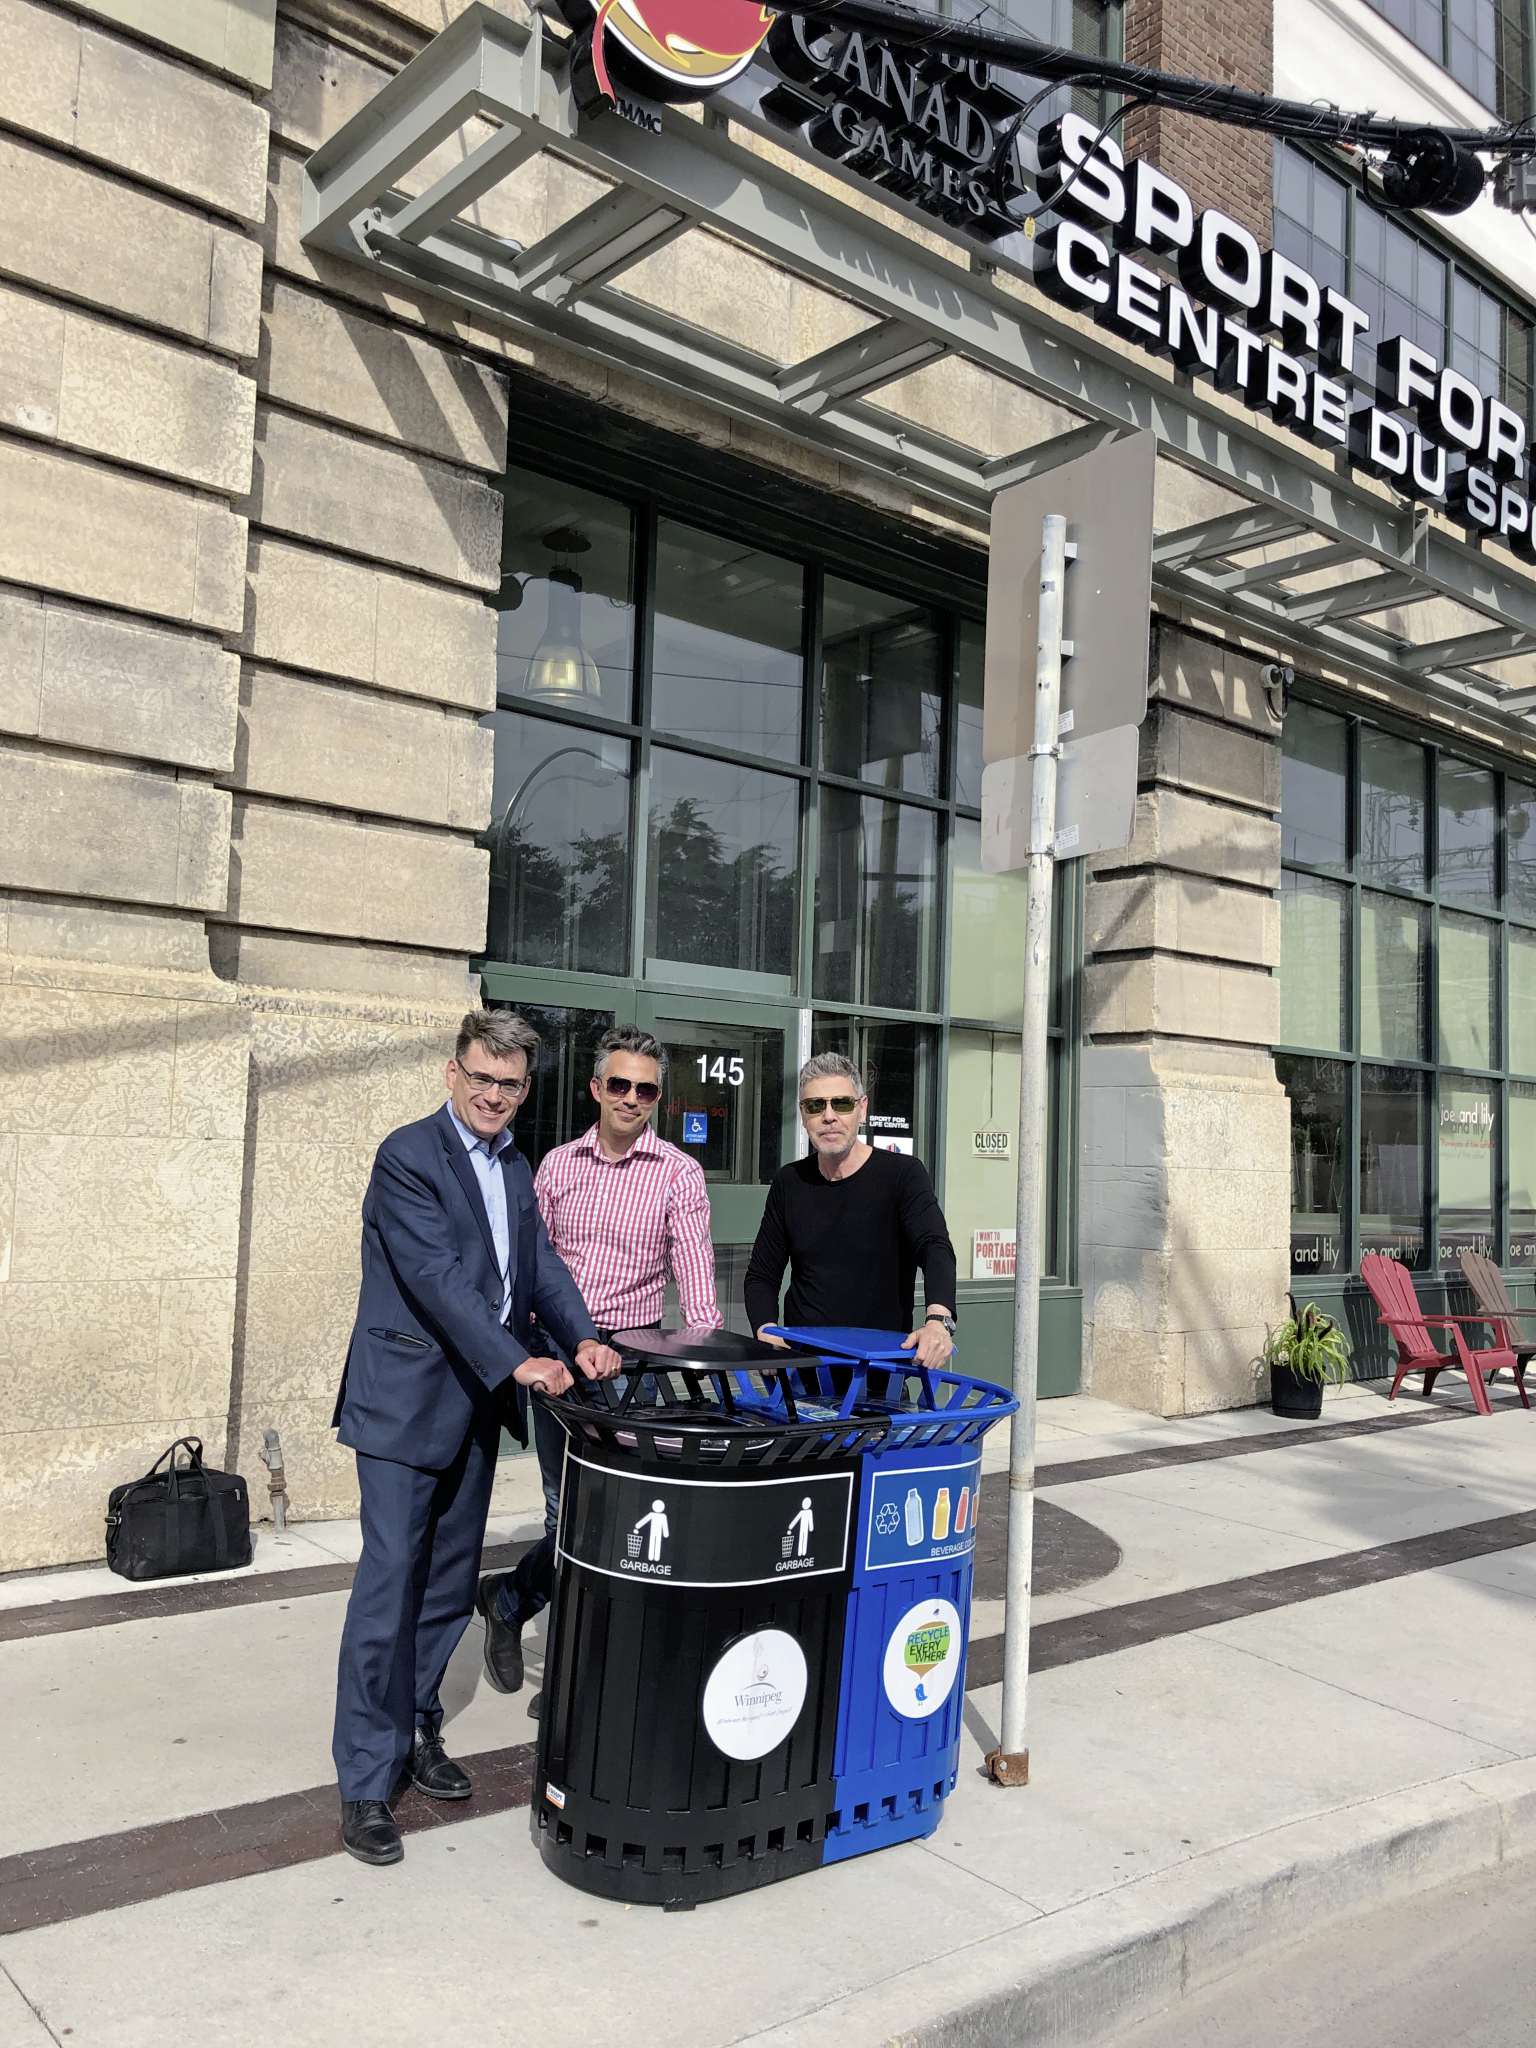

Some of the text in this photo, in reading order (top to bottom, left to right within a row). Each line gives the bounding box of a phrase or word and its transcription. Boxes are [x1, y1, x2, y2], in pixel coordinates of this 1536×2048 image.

[832, 101, 988, 217] GAMES
[1060, 112, 1526, 480] SPORT FOR
[1056, 221, 1536, 552] CENTRE DU SP
[697, 1054, 745, 1087] 145
[1440, 1102, 1495, 1132] joe and lily
[975, 1133, 1008, 1148] CLOSED
[979, 1231, 993, 1241] WANT
[994, 1231, 1000, 1241] TO
[976, 1242, 1016, 1259] PORTAGE
[1294, 1236, 1340, 1270] and lily
[1405, 1236, 1420, 1267] lily
[1509, 1244, 1536, 1257] oe an
[993, 1259, 1016, 1275] MAIN
[931, 1541, 965, 1557] BEVERAGE
[620, 1559, 671, 1575] GARBAGE
[775, 1557, 815, 1572] GARBAGE
[907, 1625, 950, 1645] RECYCLE
[910, 1640, 941, 1656] EVERY
[915, 1650, 946, 1662] WHERE
[734, 1690, 784, 1708] Winnipeg
